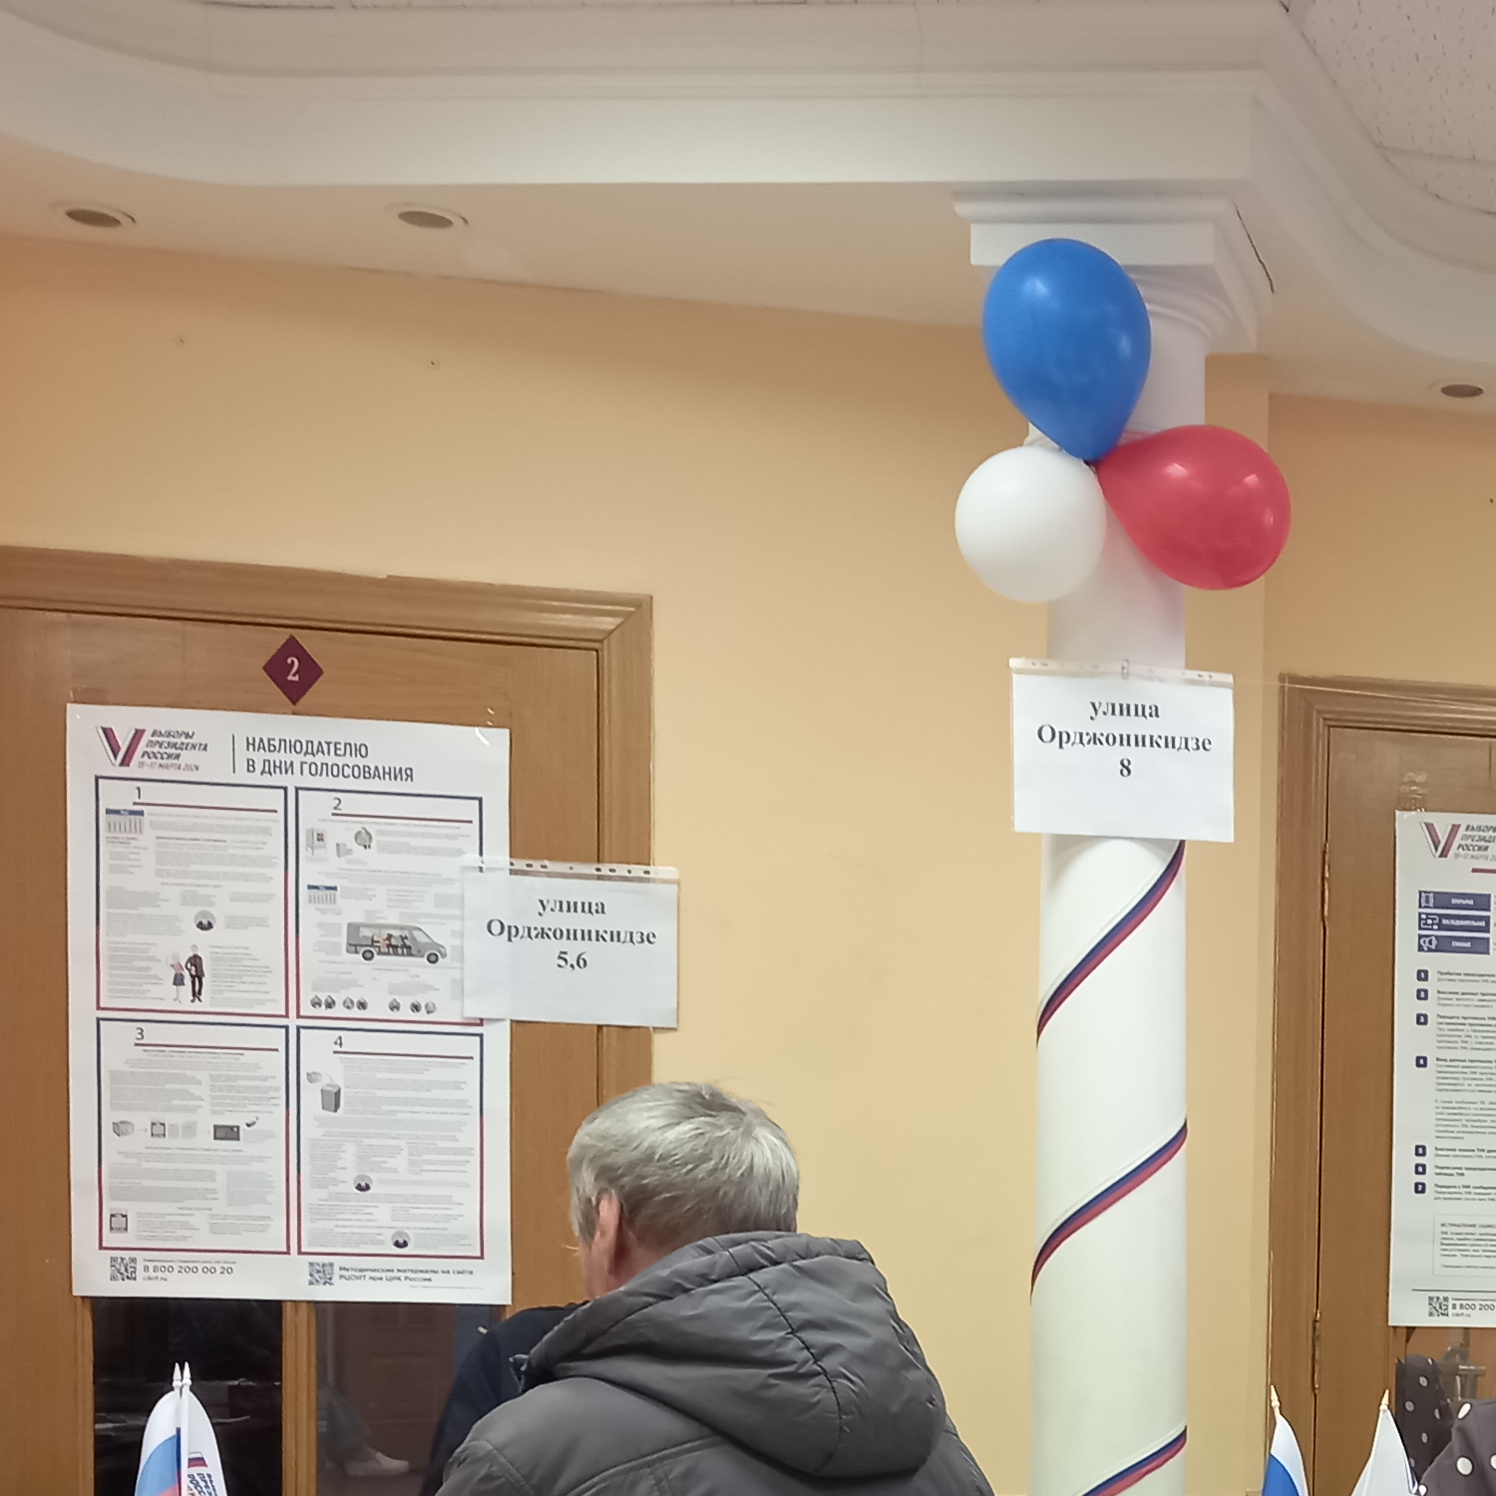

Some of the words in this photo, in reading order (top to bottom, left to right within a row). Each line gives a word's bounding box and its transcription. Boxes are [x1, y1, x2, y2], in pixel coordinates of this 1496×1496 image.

[286, 656, 299, 682] 2
[1089, 701, 1160, 720] улица
[145, 739, 208, 752] ПРЕЗИДЕНТА
[246, 736, 369, 758] НАБЛЮДАТЕЛЮ
[1037, 724, 1213, 752] Орджоникидзе
[141, 750, 181, 761] РОССИИ
[246, 758, 255, 773] В
[260, 759, 294, 777] ДНИ
[300, 761, 414, 782] ГОЛОСОВАНИЯ
[1118, 757, 1132, 777] 8
[135, 787, 142, 800] 1
[333, 797, 342, 811] 2
[537, 898, 606, 917] улица
[486, 918, 657, 945] Орджоникидзе
[556, 950, 588, 972] 5,6
[135, 1027, 145, 1041] 3
[333, 1035, 343, 1048] 4
[143, 1265, 149, 1273] 8
[153, 1265, 174, 1274] 800
[178, 1265, 199, 1274] 200
[202, 1266, 217, 1274] 00
[220, 1266, 233, 1275] 20
[1459, 1303, 1476, 1311] 800
[1478, 1303, 1495, 1311] 200
